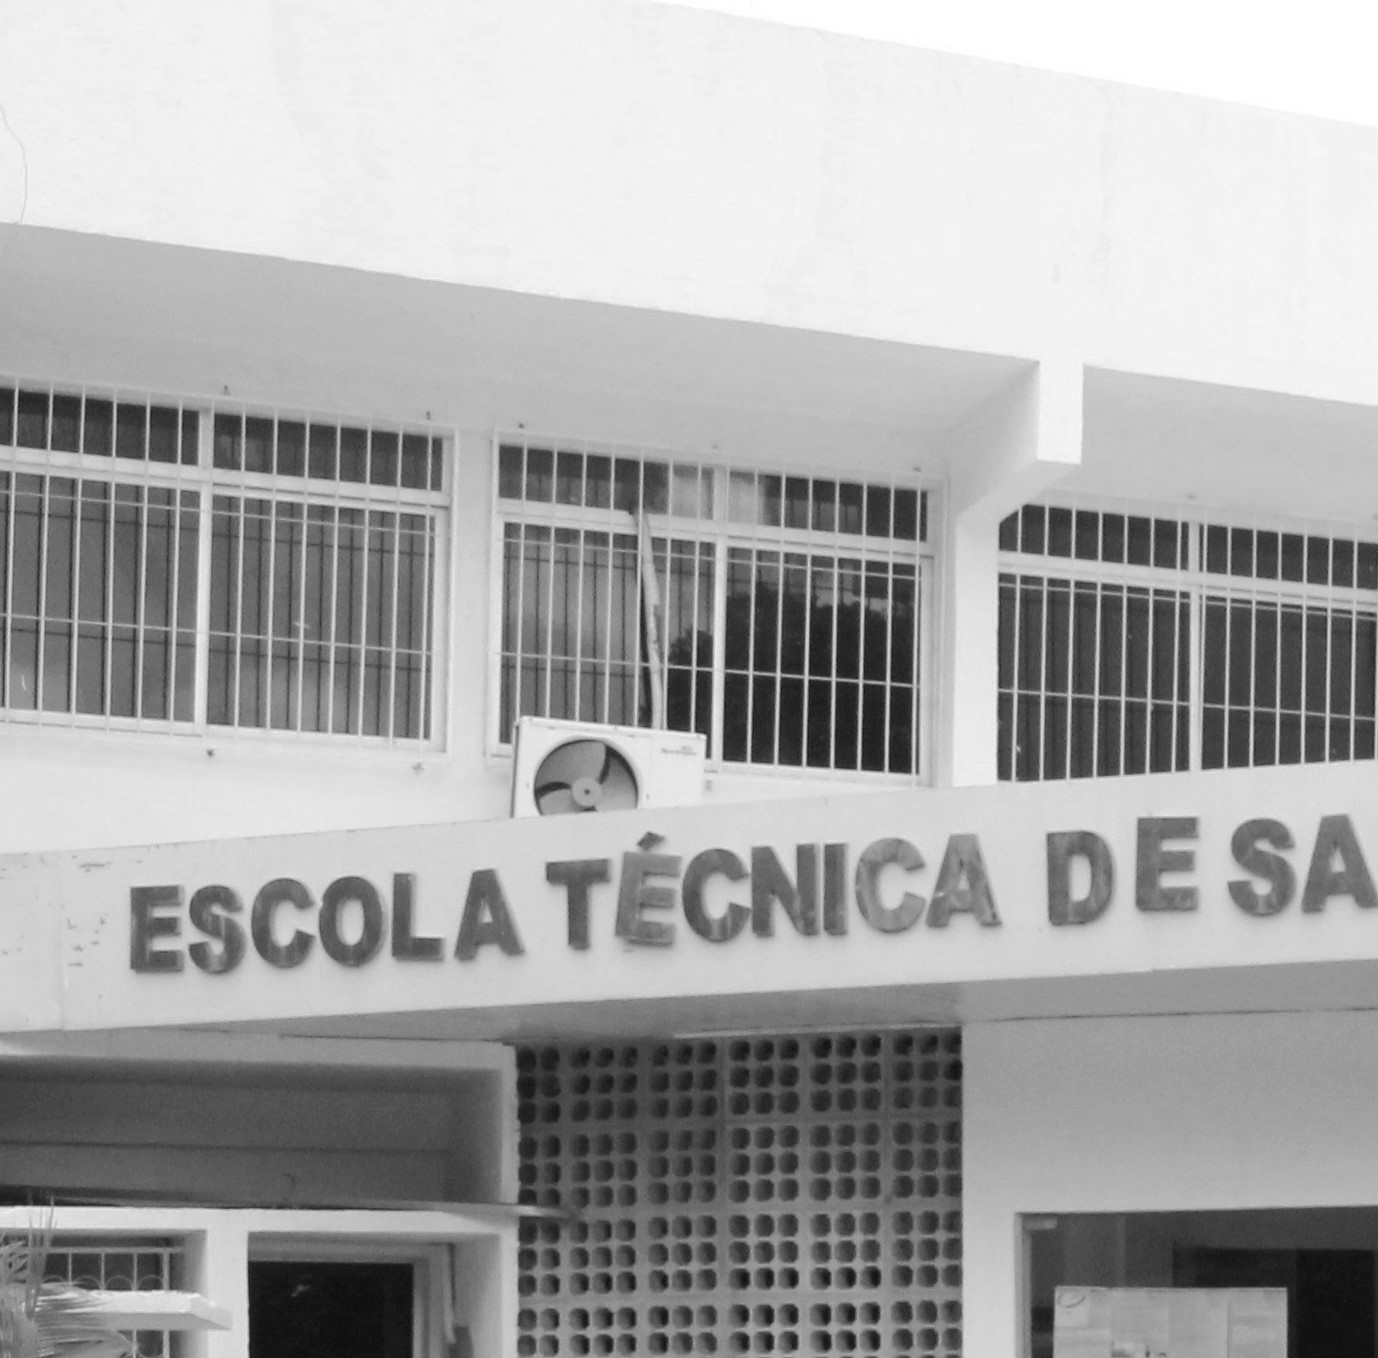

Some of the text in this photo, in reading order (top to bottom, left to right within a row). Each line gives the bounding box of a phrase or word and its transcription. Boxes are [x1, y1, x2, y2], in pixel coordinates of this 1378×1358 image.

[130, 869, 525, 976] ESCOLA
[545, 830, 1003, 951] TÉCNICA
[1046, 817, 1200, 929] DE
